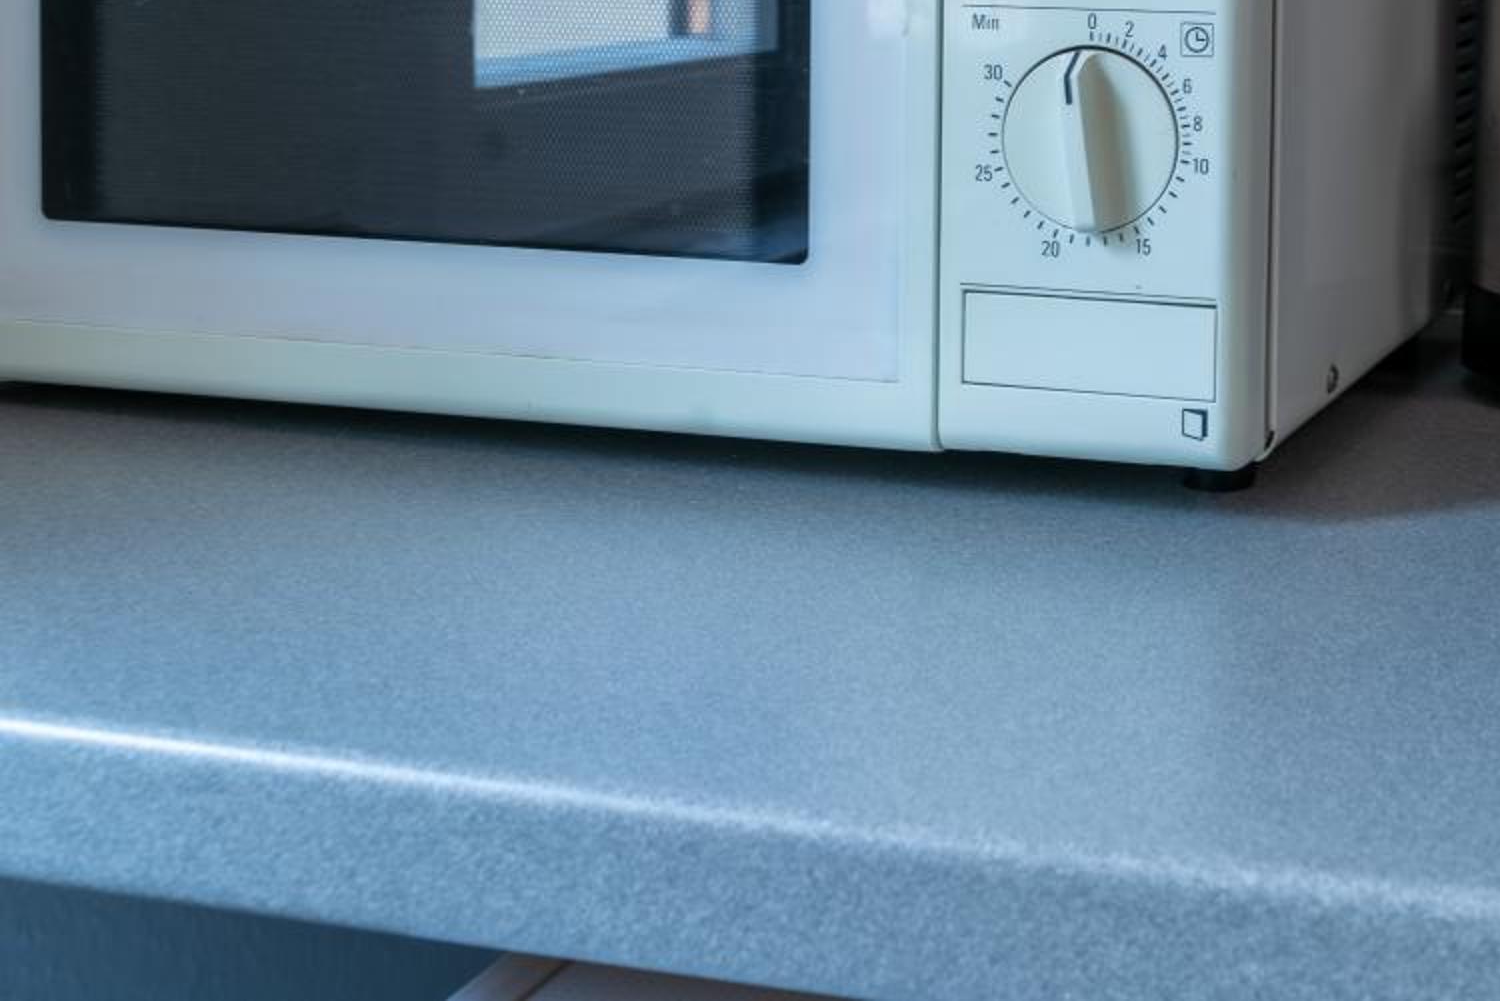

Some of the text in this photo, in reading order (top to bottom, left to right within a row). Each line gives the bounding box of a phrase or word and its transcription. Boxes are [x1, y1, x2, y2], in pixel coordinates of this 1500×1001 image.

[972, 13, 1000, 31] Min
[1087, 13, 1097, 30] 0
[1125, 21, 1135, 38] 2
[1157, 44, 1168, 61] 4
[984, 64, 1003, 81] 30
[1183, 78, 1193, 95] 6
[1193, 116, 1203, 132] 8
[975, 165, 993, 182] 25
[1193, 158, 1209, 175] 10
[1041, 241, 1061, 258] 20
[1136, 238, 1151, 255] 15
